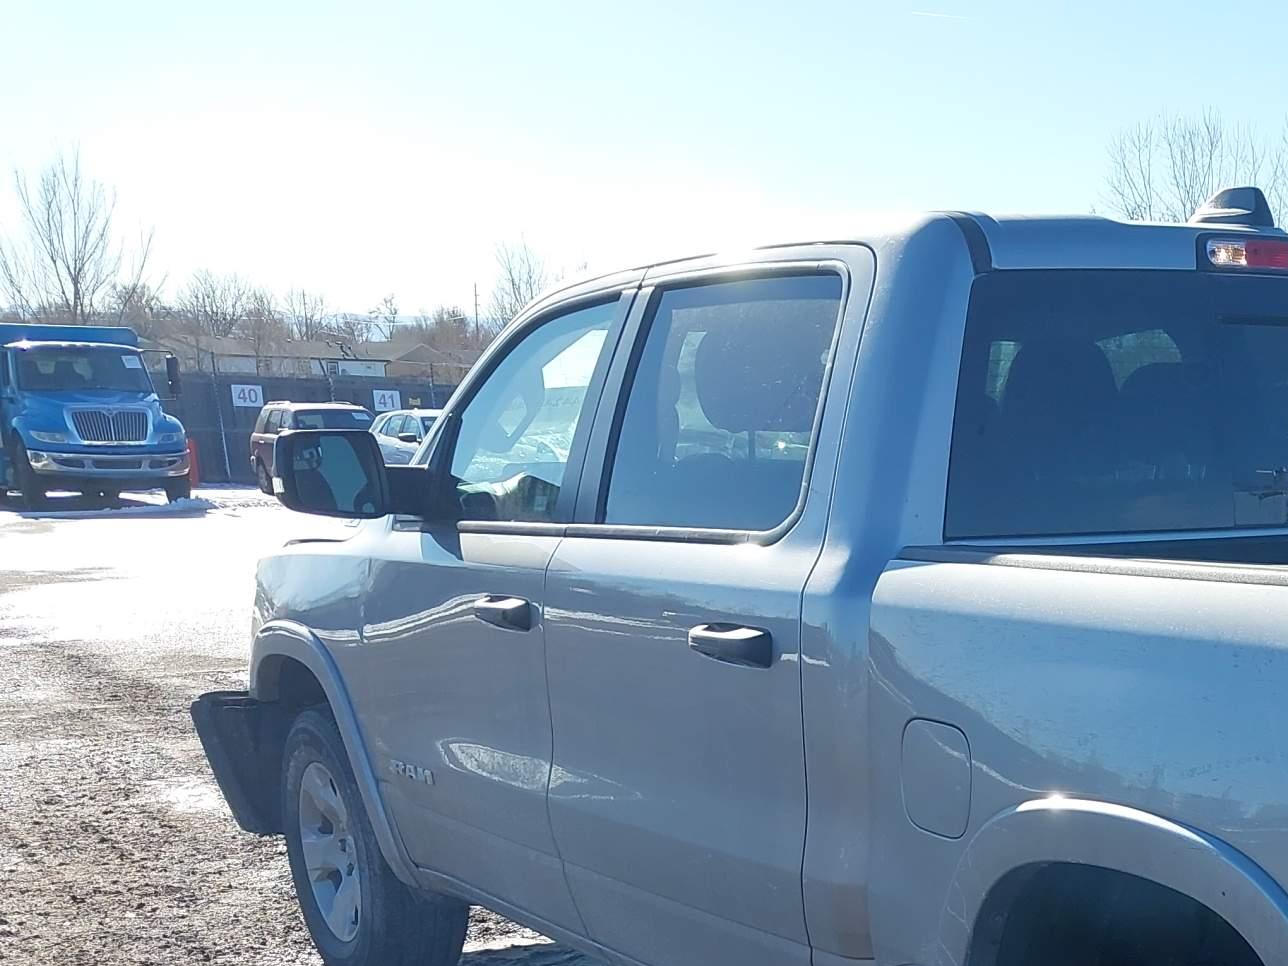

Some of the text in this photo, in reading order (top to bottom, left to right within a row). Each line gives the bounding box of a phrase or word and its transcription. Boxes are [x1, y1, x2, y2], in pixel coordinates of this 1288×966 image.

[237, 388, 258, 404] 40
[378, 393, 395, 408] 41
[389, 758, 435, 785] RAM
